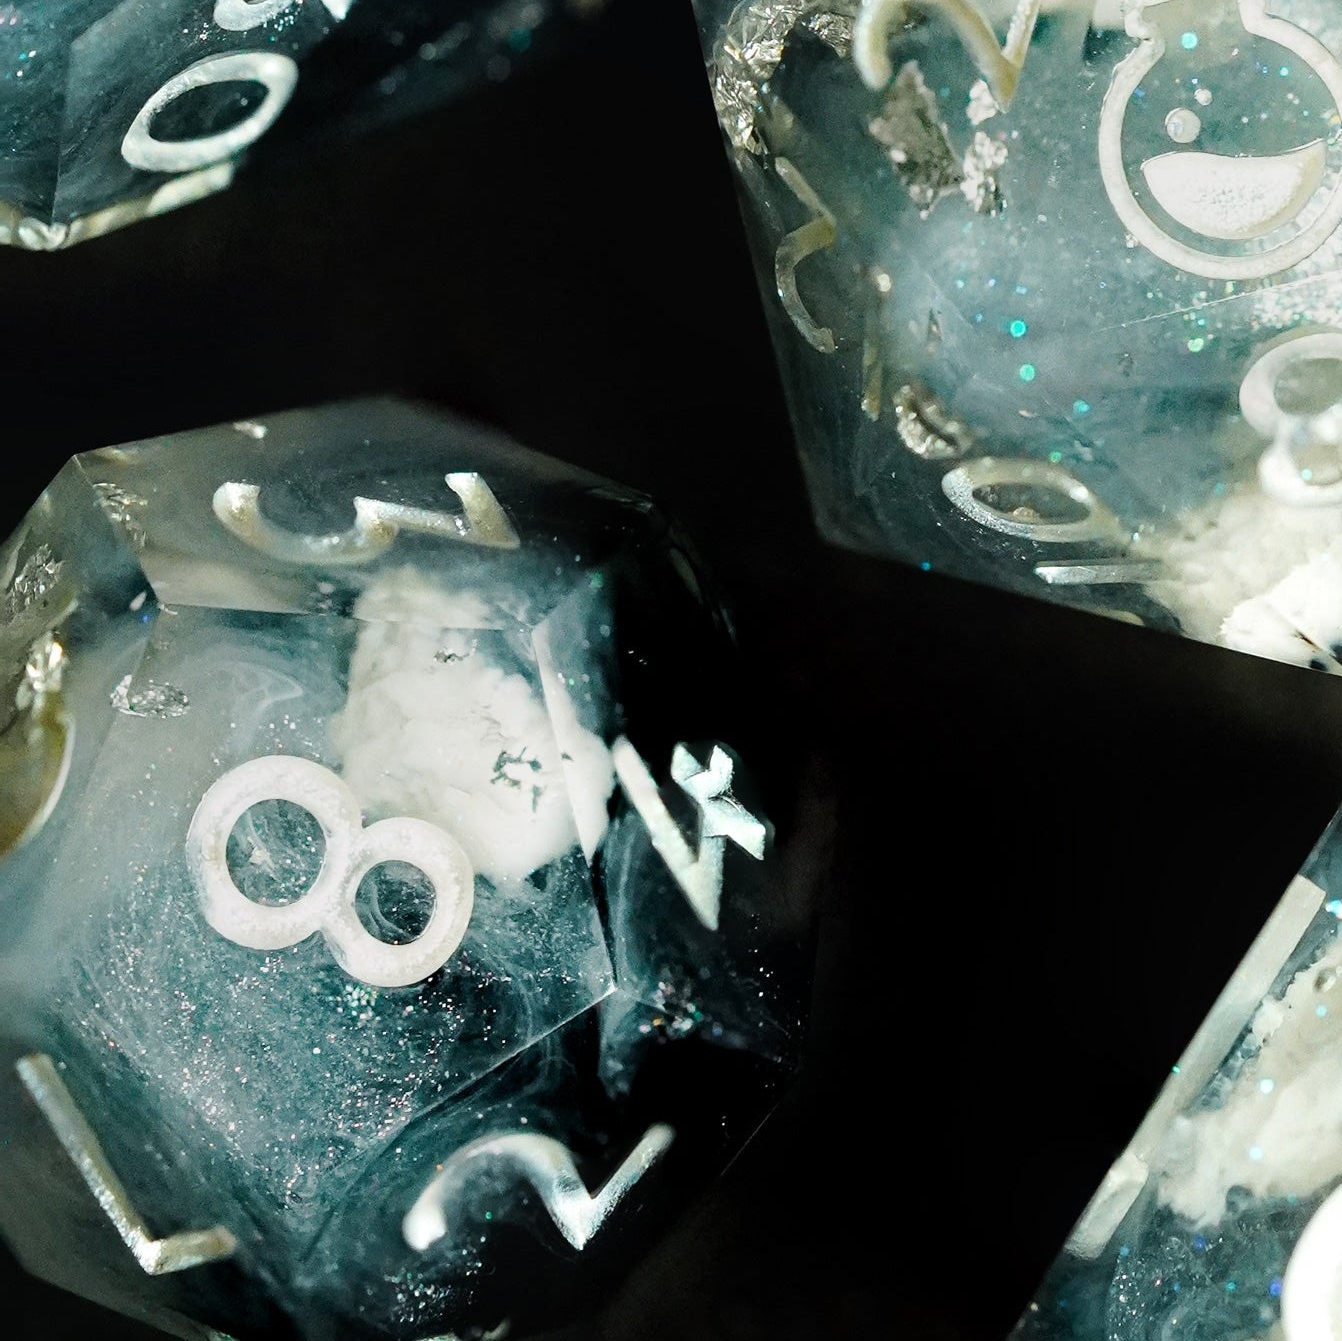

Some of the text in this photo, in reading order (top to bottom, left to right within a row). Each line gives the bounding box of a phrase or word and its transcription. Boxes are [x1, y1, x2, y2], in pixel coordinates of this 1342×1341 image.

[187, 755, 474, 988] 8
[612, 733, 768, 932] 4
[402, 1123, 676, 1251] 2
